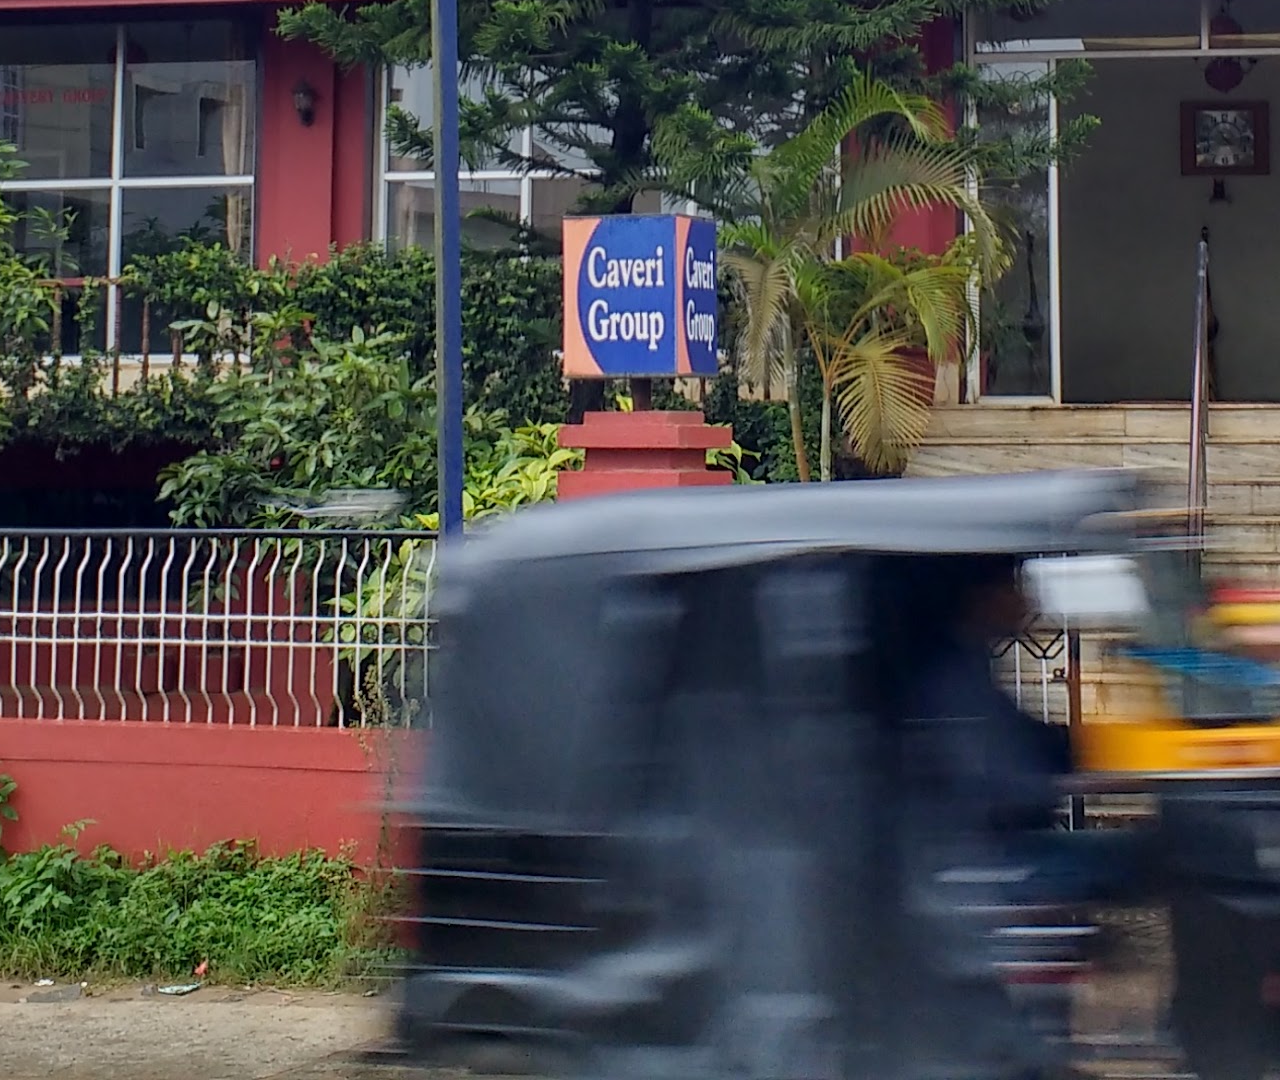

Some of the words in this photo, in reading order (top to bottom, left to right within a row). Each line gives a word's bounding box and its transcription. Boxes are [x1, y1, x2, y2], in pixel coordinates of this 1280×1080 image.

[587, 245, 665, 289] Caveri
[685, 246, 715, 290] Caveri
[587, 299, 665, 350] Group
[686, 299, 715, 351] Group
